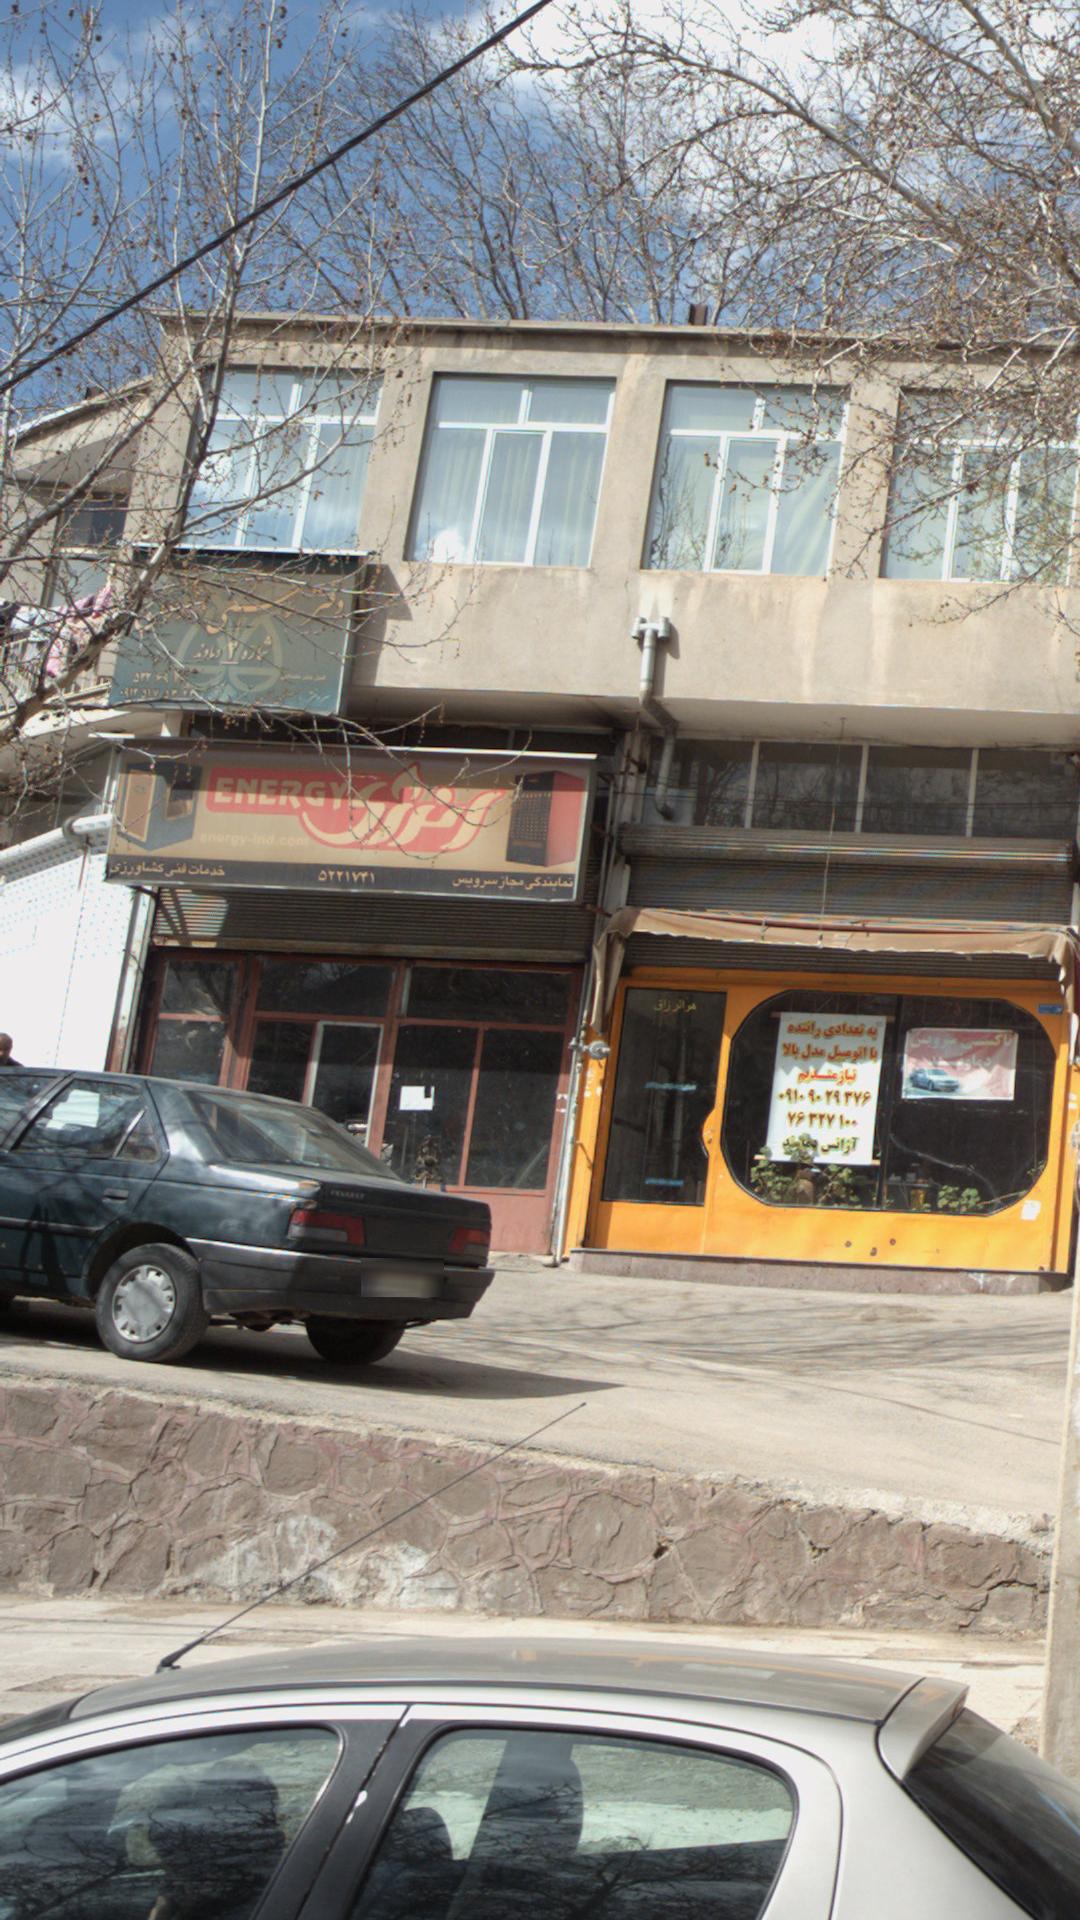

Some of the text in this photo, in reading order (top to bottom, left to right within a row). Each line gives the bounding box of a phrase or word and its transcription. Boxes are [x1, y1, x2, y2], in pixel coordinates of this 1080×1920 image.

[213, 776, 349, 810] ENERGY
[188, 863, 225, 877] خدمات
[787, 1020, 821, 1038] راننده
[823, 1022, 865, 1039] تعدادی
[782, 1042, 800, 1059] بالا
[801, 1043, 825, 1060] مدل
